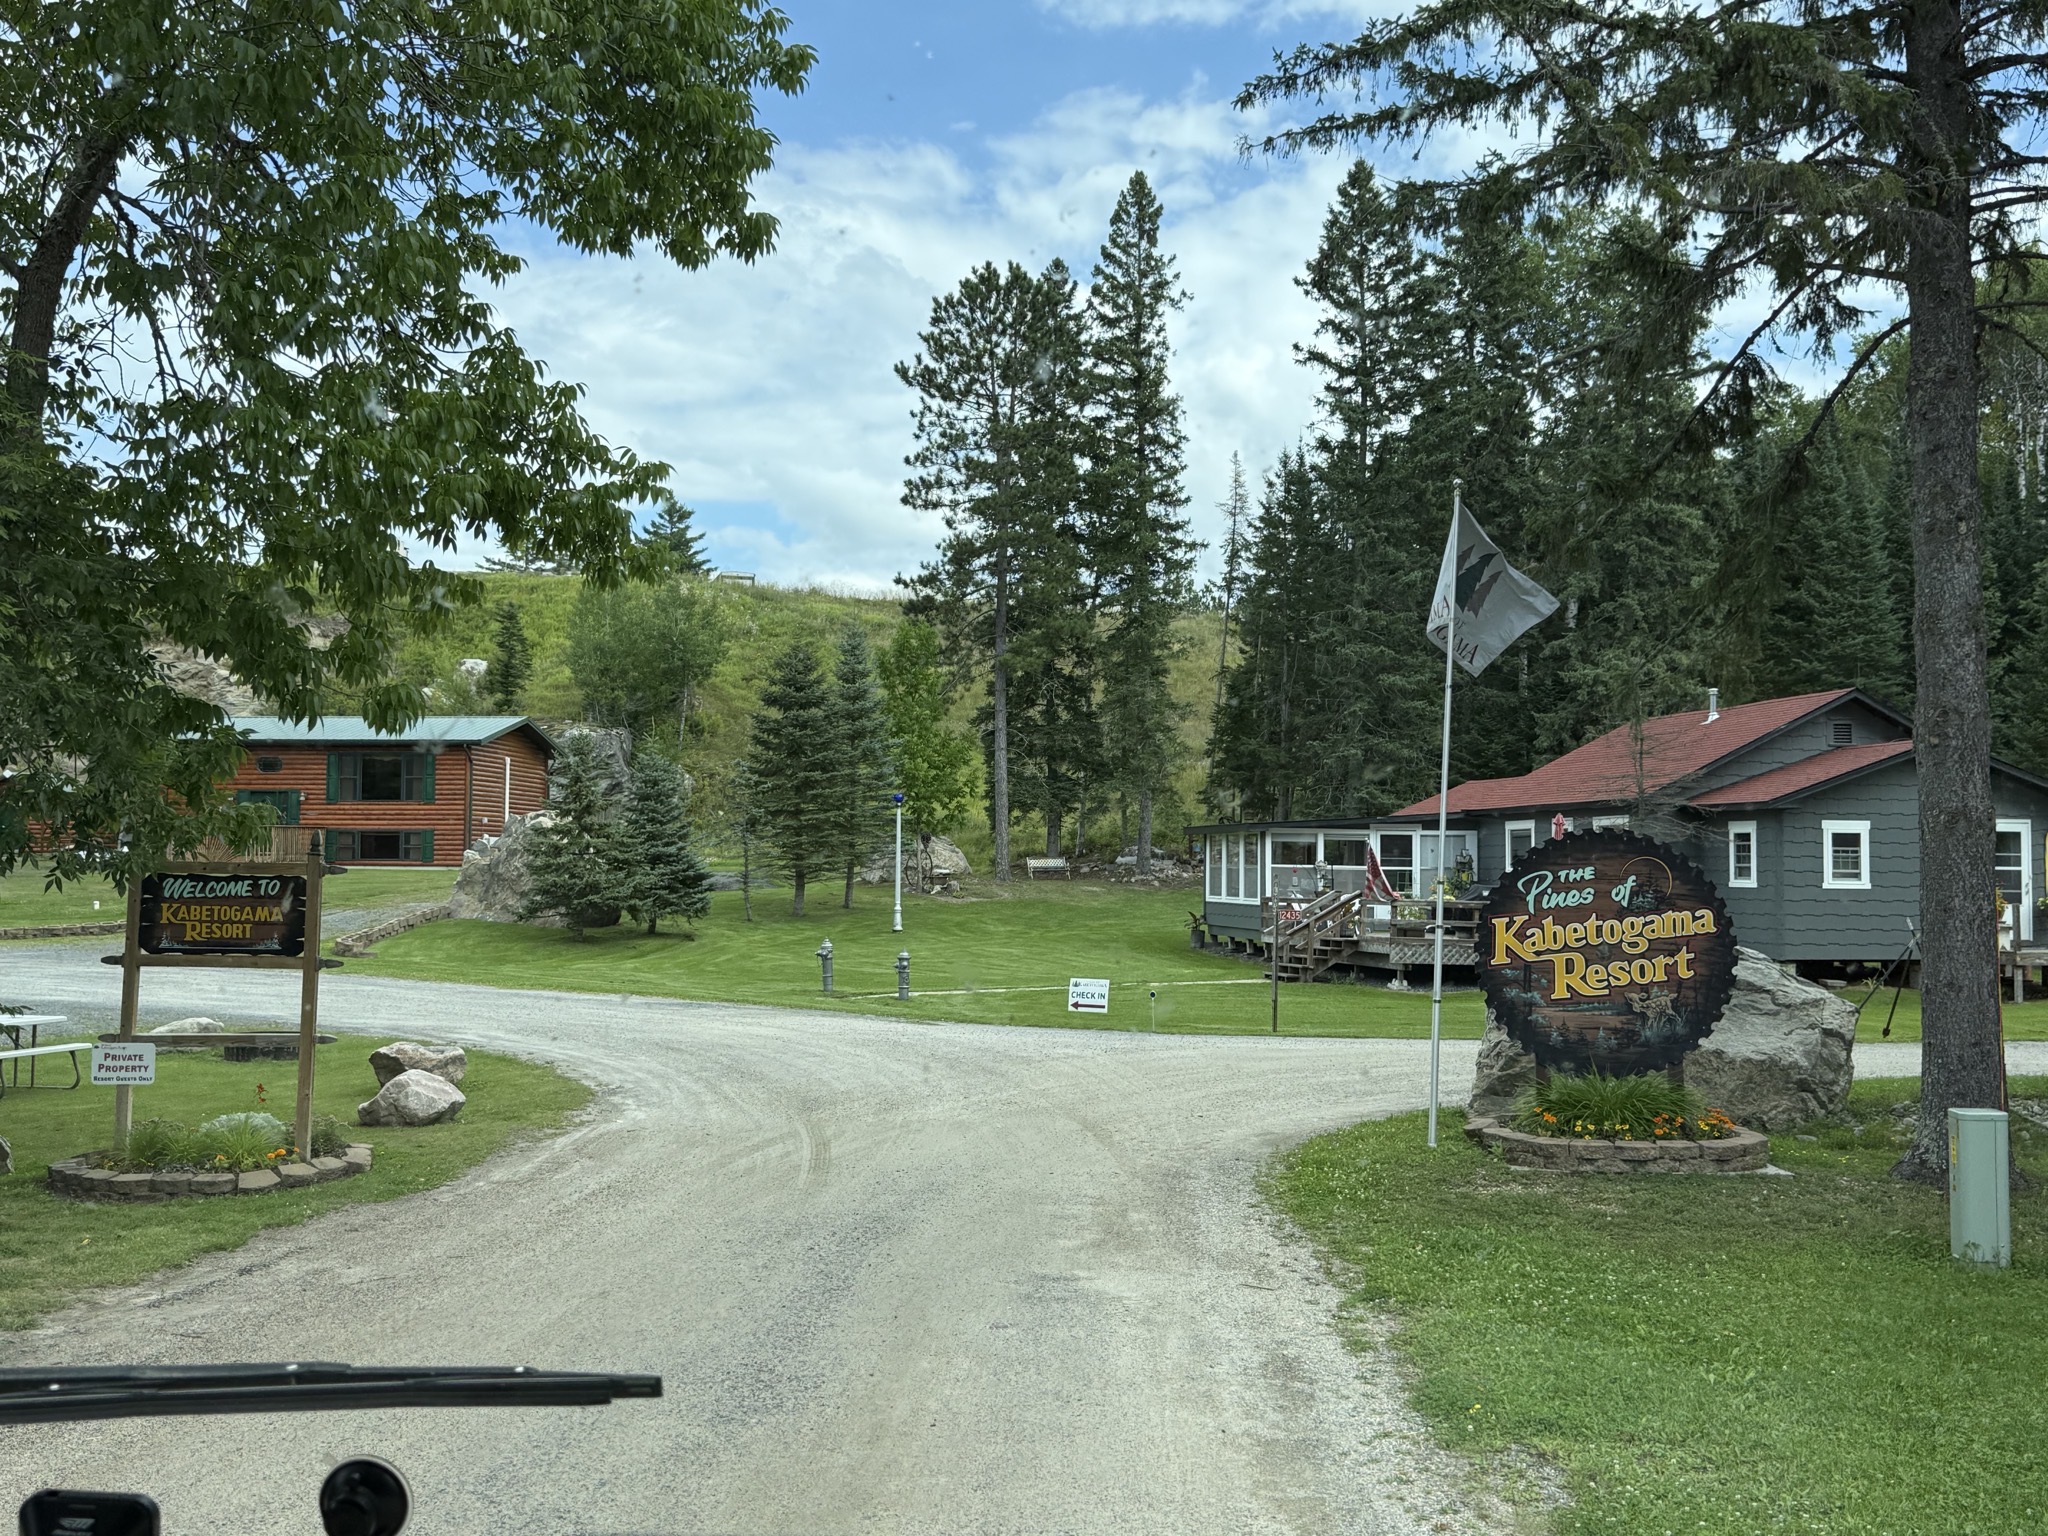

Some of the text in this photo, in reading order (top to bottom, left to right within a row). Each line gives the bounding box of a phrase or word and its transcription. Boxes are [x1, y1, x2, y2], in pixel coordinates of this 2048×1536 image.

[1557, 866, 1596, 884] THE
[163, 878, 280, 899] WELCOME TO
[1517, 871, 1637, 914] Pines of
[160, 903, 284, 924] KABETOGAMA
[1279, 911, 1301, 920] 12435
[184, 922, 253, 941] RESORT
[1491, 908, 1718, 966] Kabetogama
[1551, 946, 1696, 1000] Resort
[1071, 990, 1106, 1001] CHECK IN
[103, 1052, 145, 1062] PRIVATE
[97, 1063, 150, 1073] PROPERTY
